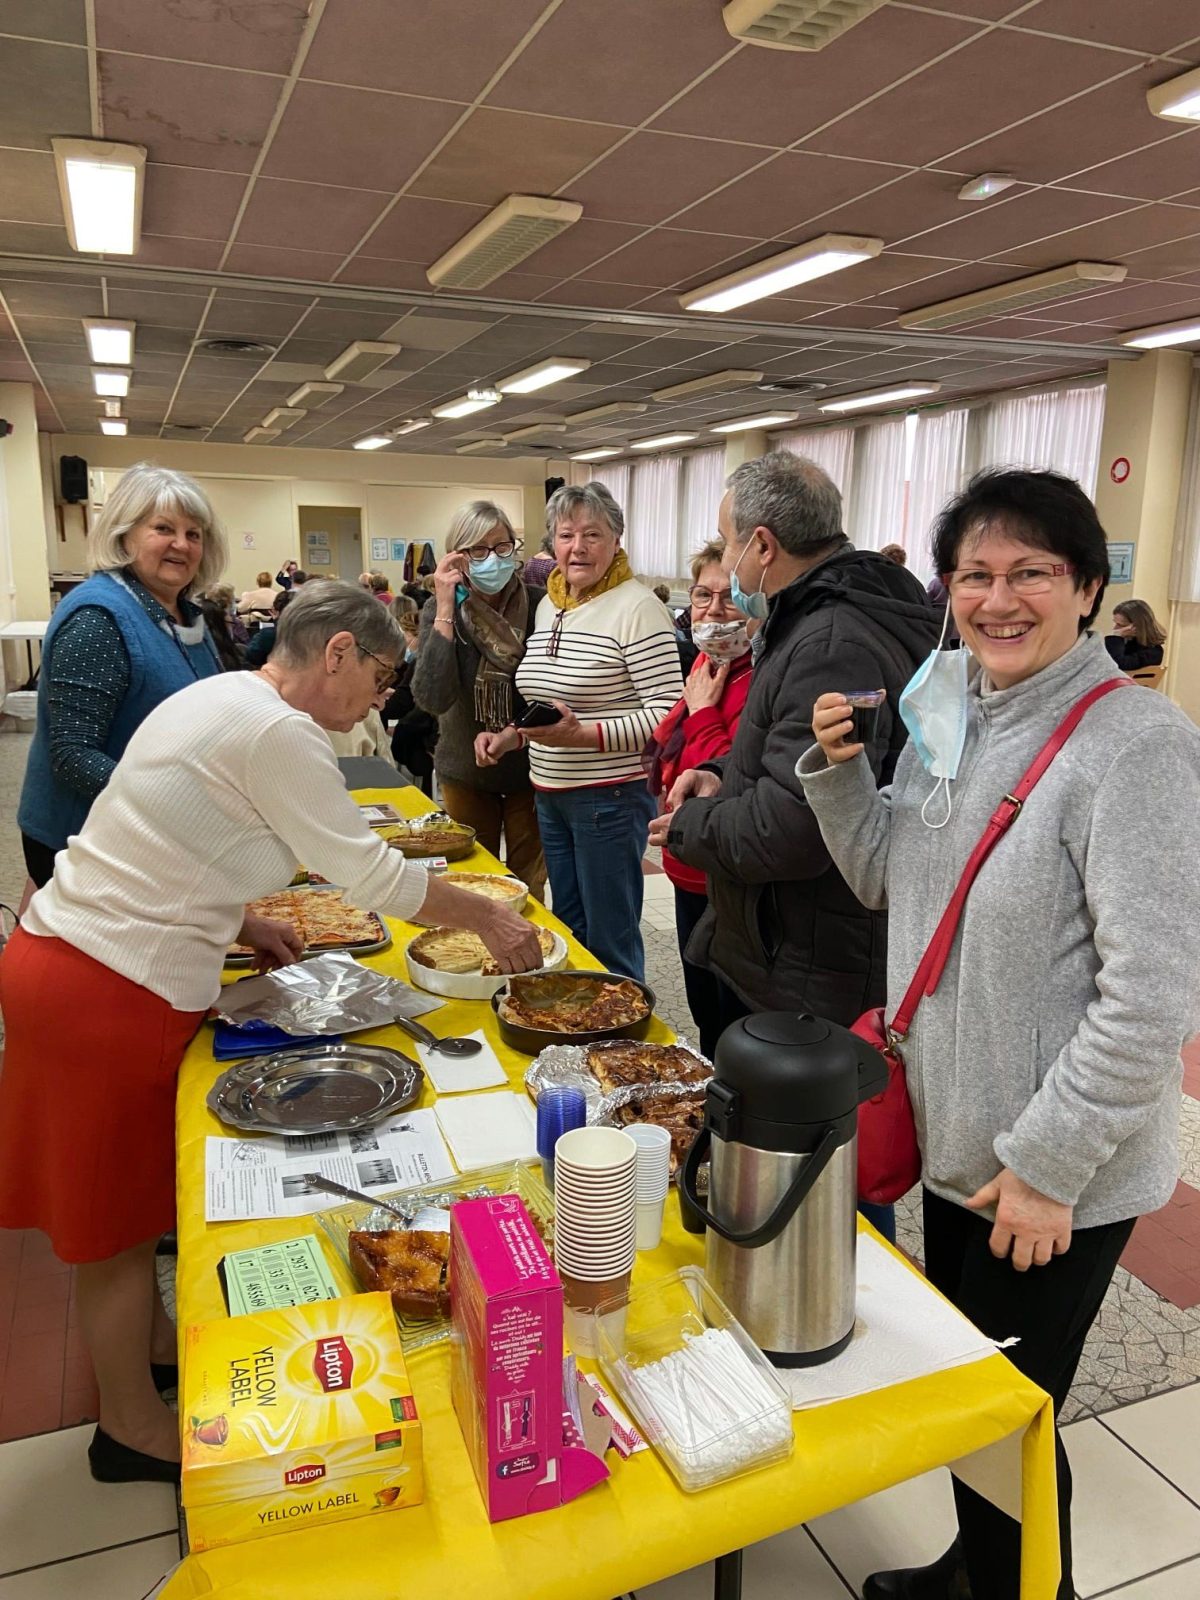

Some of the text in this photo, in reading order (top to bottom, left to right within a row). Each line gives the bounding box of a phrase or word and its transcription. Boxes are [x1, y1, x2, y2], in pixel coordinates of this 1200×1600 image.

[230, 1358, 252, 1408] LABEL
[252, 1346, 277, 1407] YELLOW
[320, 1340, 344, 1388] Lipton
[288, 1467, 323, 1482] Lipton
[258, 1492, 359, 1524] YELLOW LABEL
